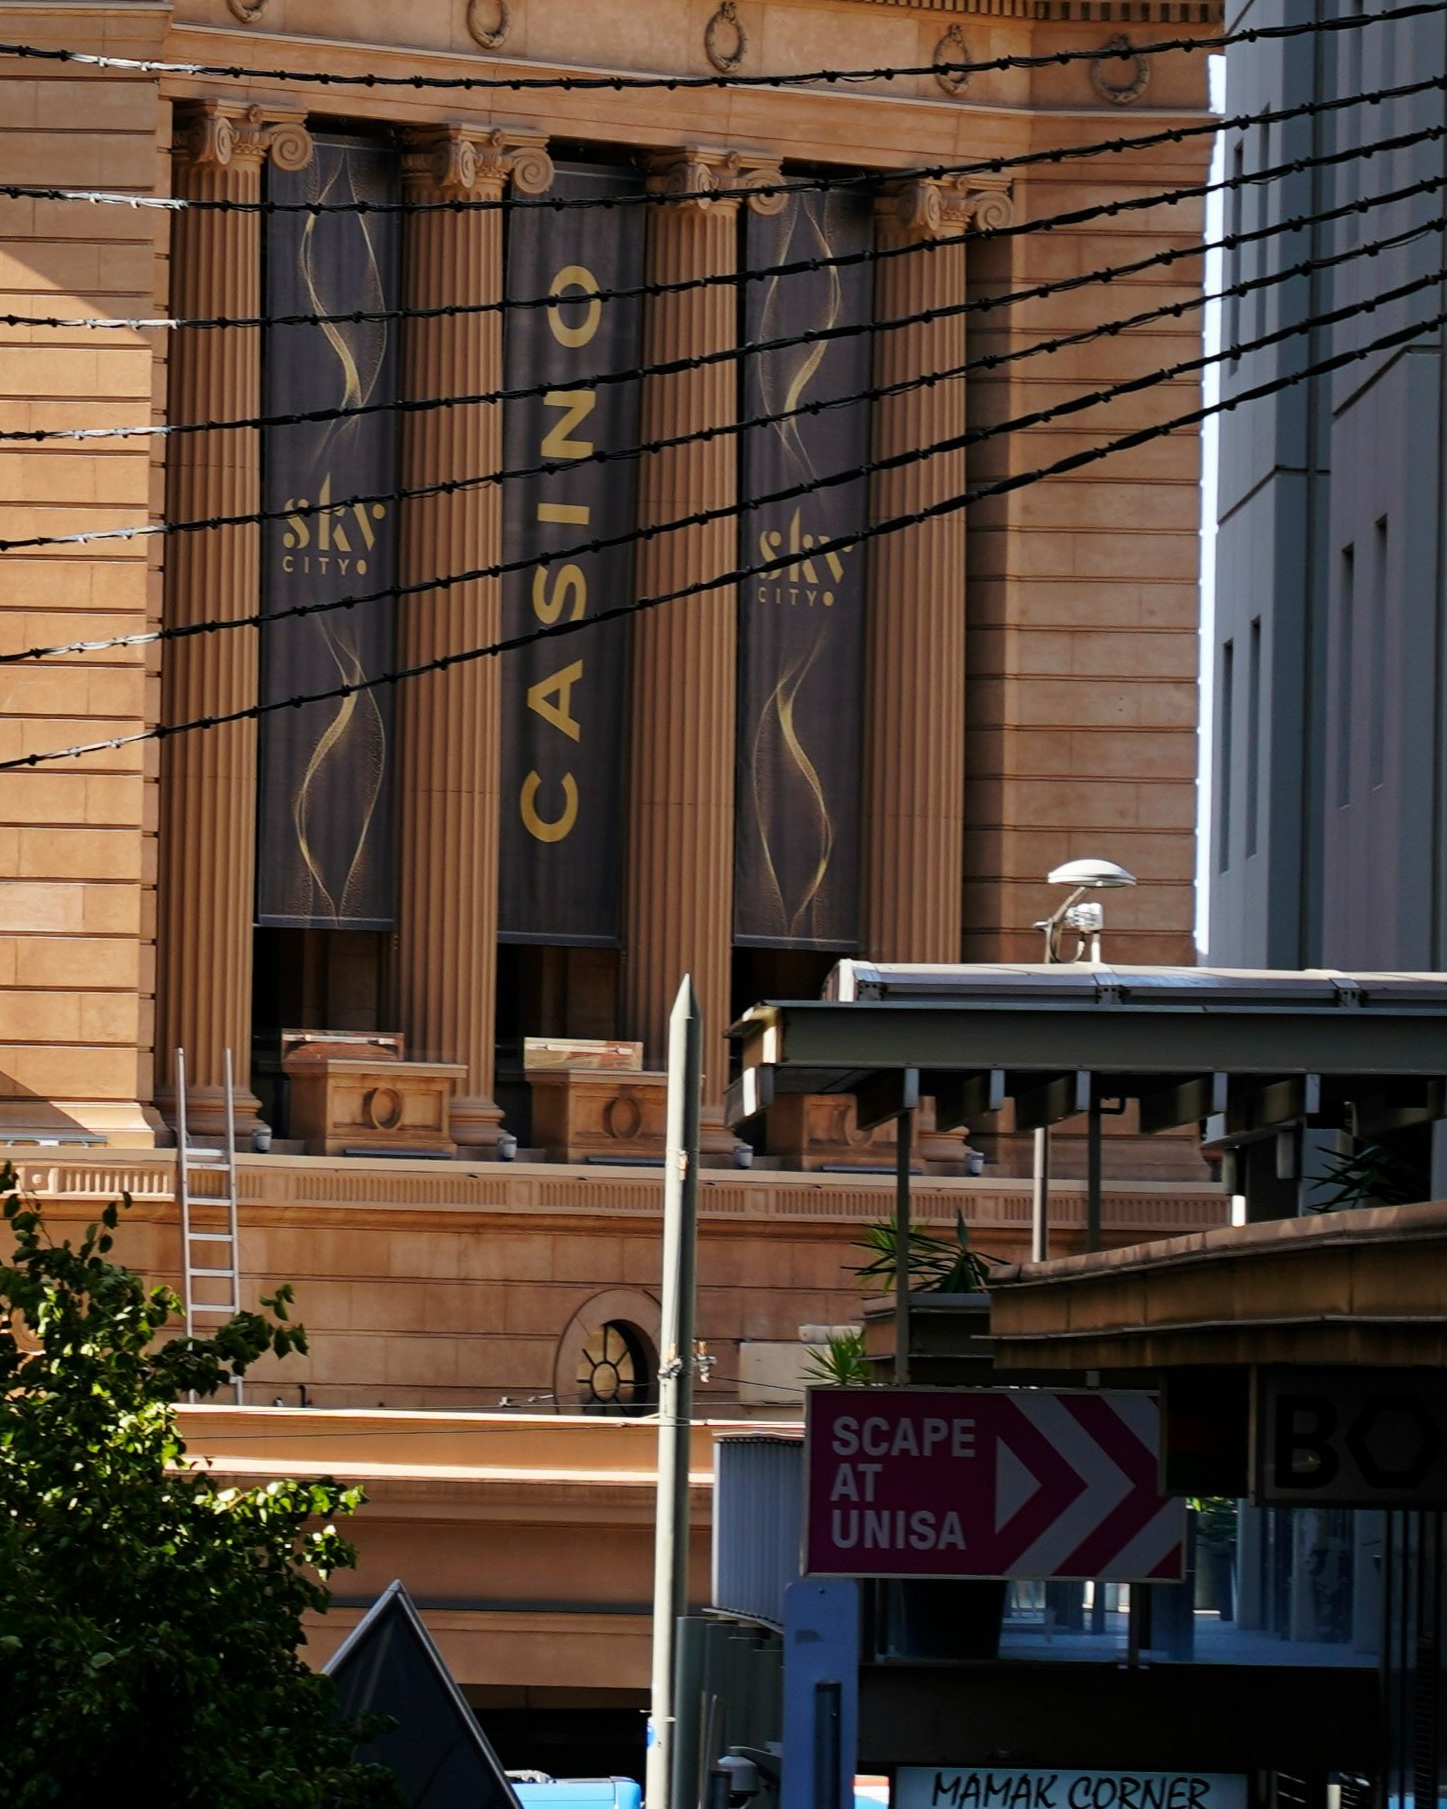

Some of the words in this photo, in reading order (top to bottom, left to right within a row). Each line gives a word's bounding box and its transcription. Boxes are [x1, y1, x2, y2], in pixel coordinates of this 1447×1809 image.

[282, 556, 350, 576] CITY
[521, 265, 602, 843] CASINO
[758, 587, 818, 607] CITY
[832, 1417, 976, 1458] SCAPE
[830, 1463, 882, 1502] AT
[831, 1510, 967, 1551] UNISA
[932, 1772, 1058, 1809] MAMAK
[1068, 1776, 1211, 1809] CORNER
